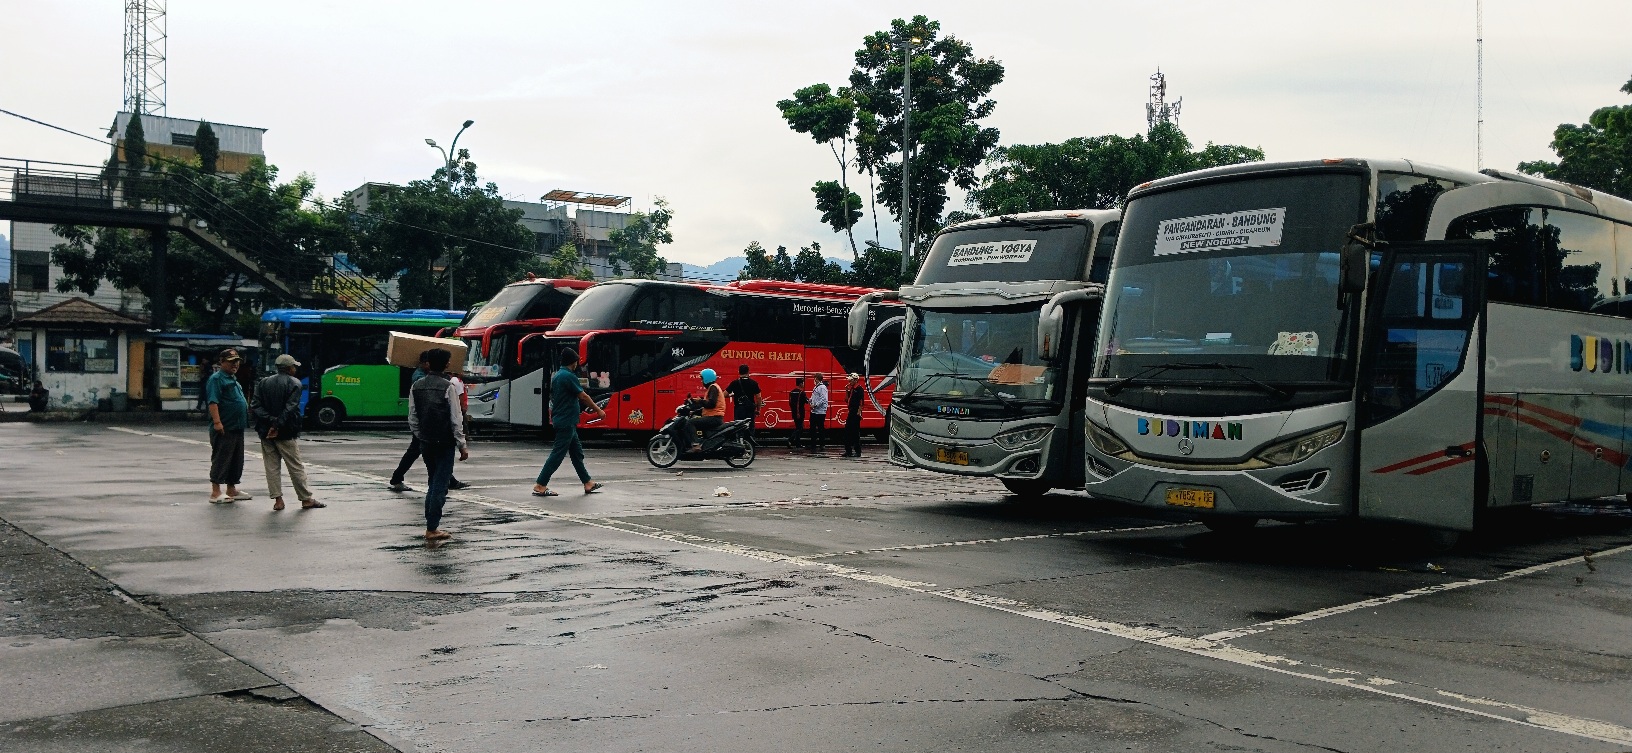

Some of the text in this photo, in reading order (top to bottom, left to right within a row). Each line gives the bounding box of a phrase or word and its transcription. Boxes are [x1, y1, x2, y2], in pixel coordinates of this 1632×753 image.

[1164, 218, 1226, 235] PANGANDARAN
[1232, 213, 1277, 228] BANDUNG
[1182, 237, 1247, 249] NEW NORMAL
[953, 245, 994, 258] BANDUNG
[1001, 243, 1032, 254] YOGYA
[721, 349, 804, 361] GUNUNG HARTA
[336, 374, 361, 383] Trans
[937, 405, 970, 415] BUDIMAN
[1137, 417, 1243, 441] BUDIMAN
